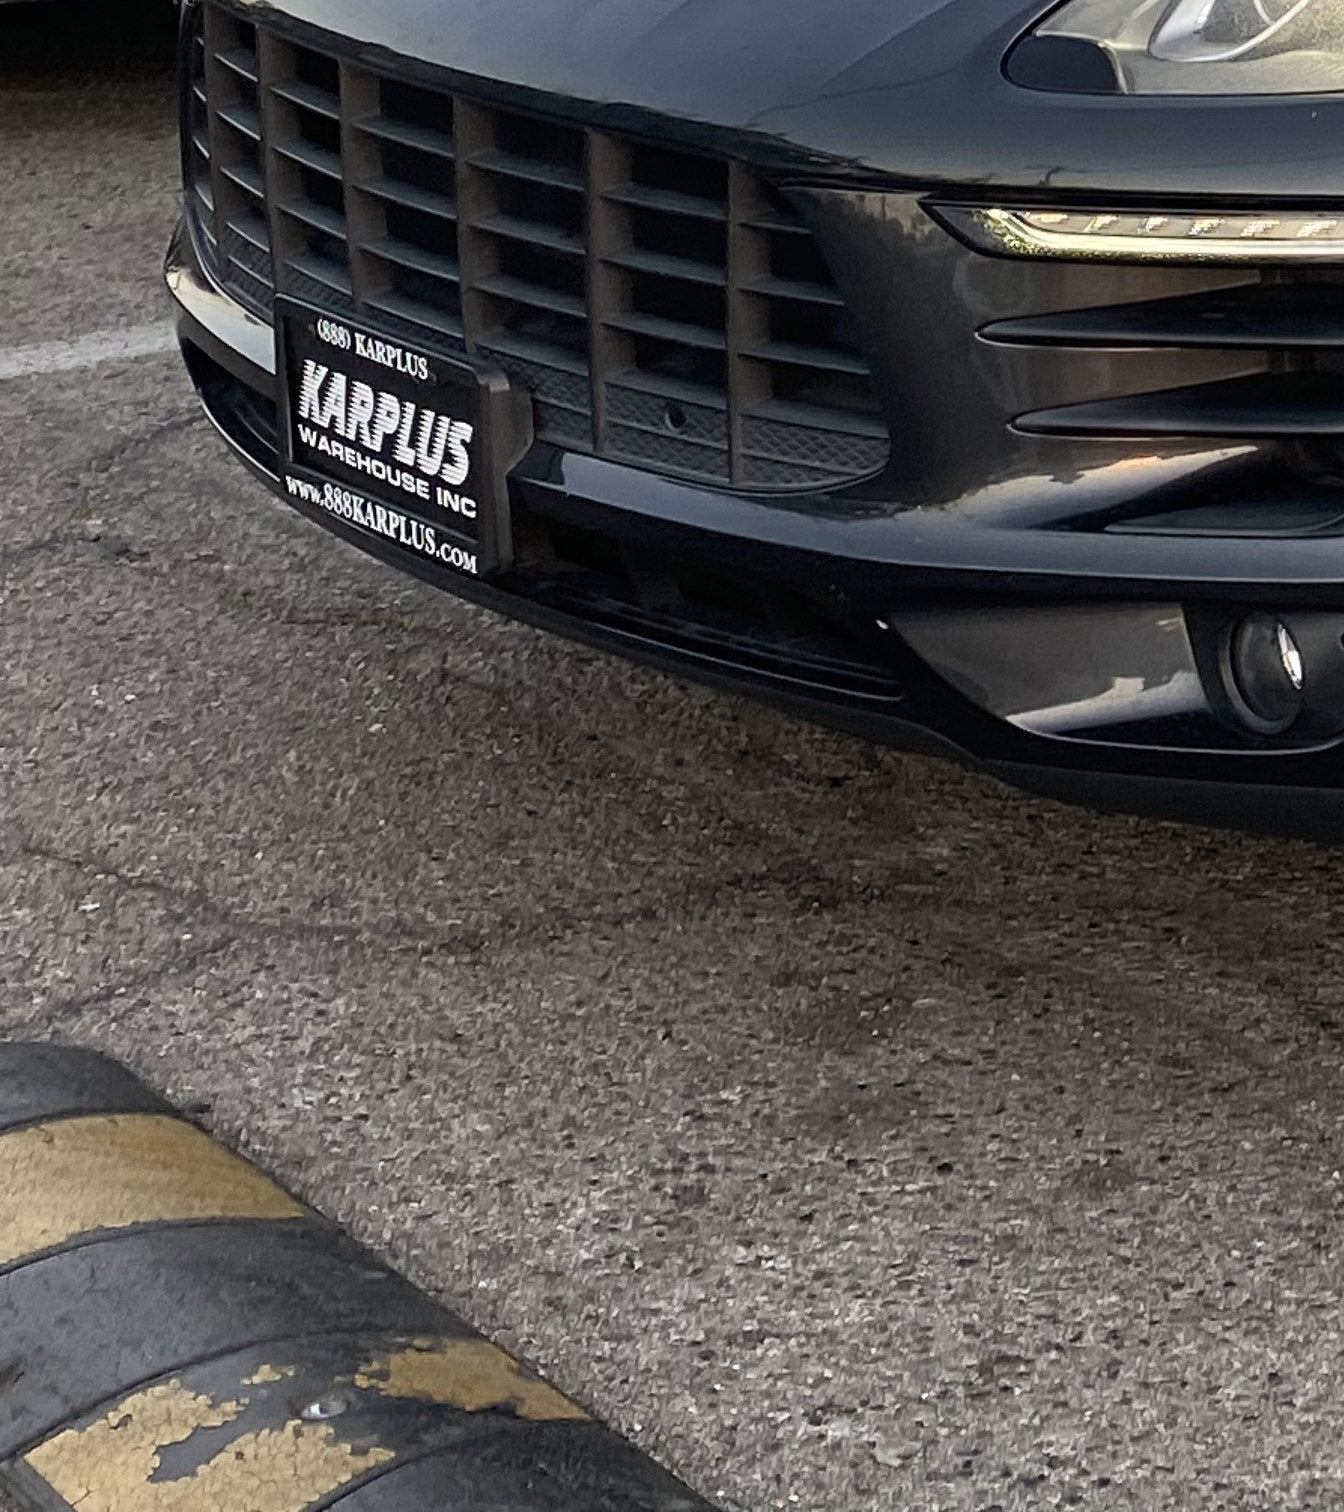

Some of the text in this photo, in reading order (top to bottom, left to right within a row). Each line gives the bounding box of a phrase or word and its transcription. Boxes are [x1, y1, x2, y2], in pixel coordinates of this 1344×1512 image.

[316, 318, 429, 380] (888) KARPLUS
[297, 358, 474, 486] KARPLUS
[298, 424, 477, 519] WAREHOUSE INC
